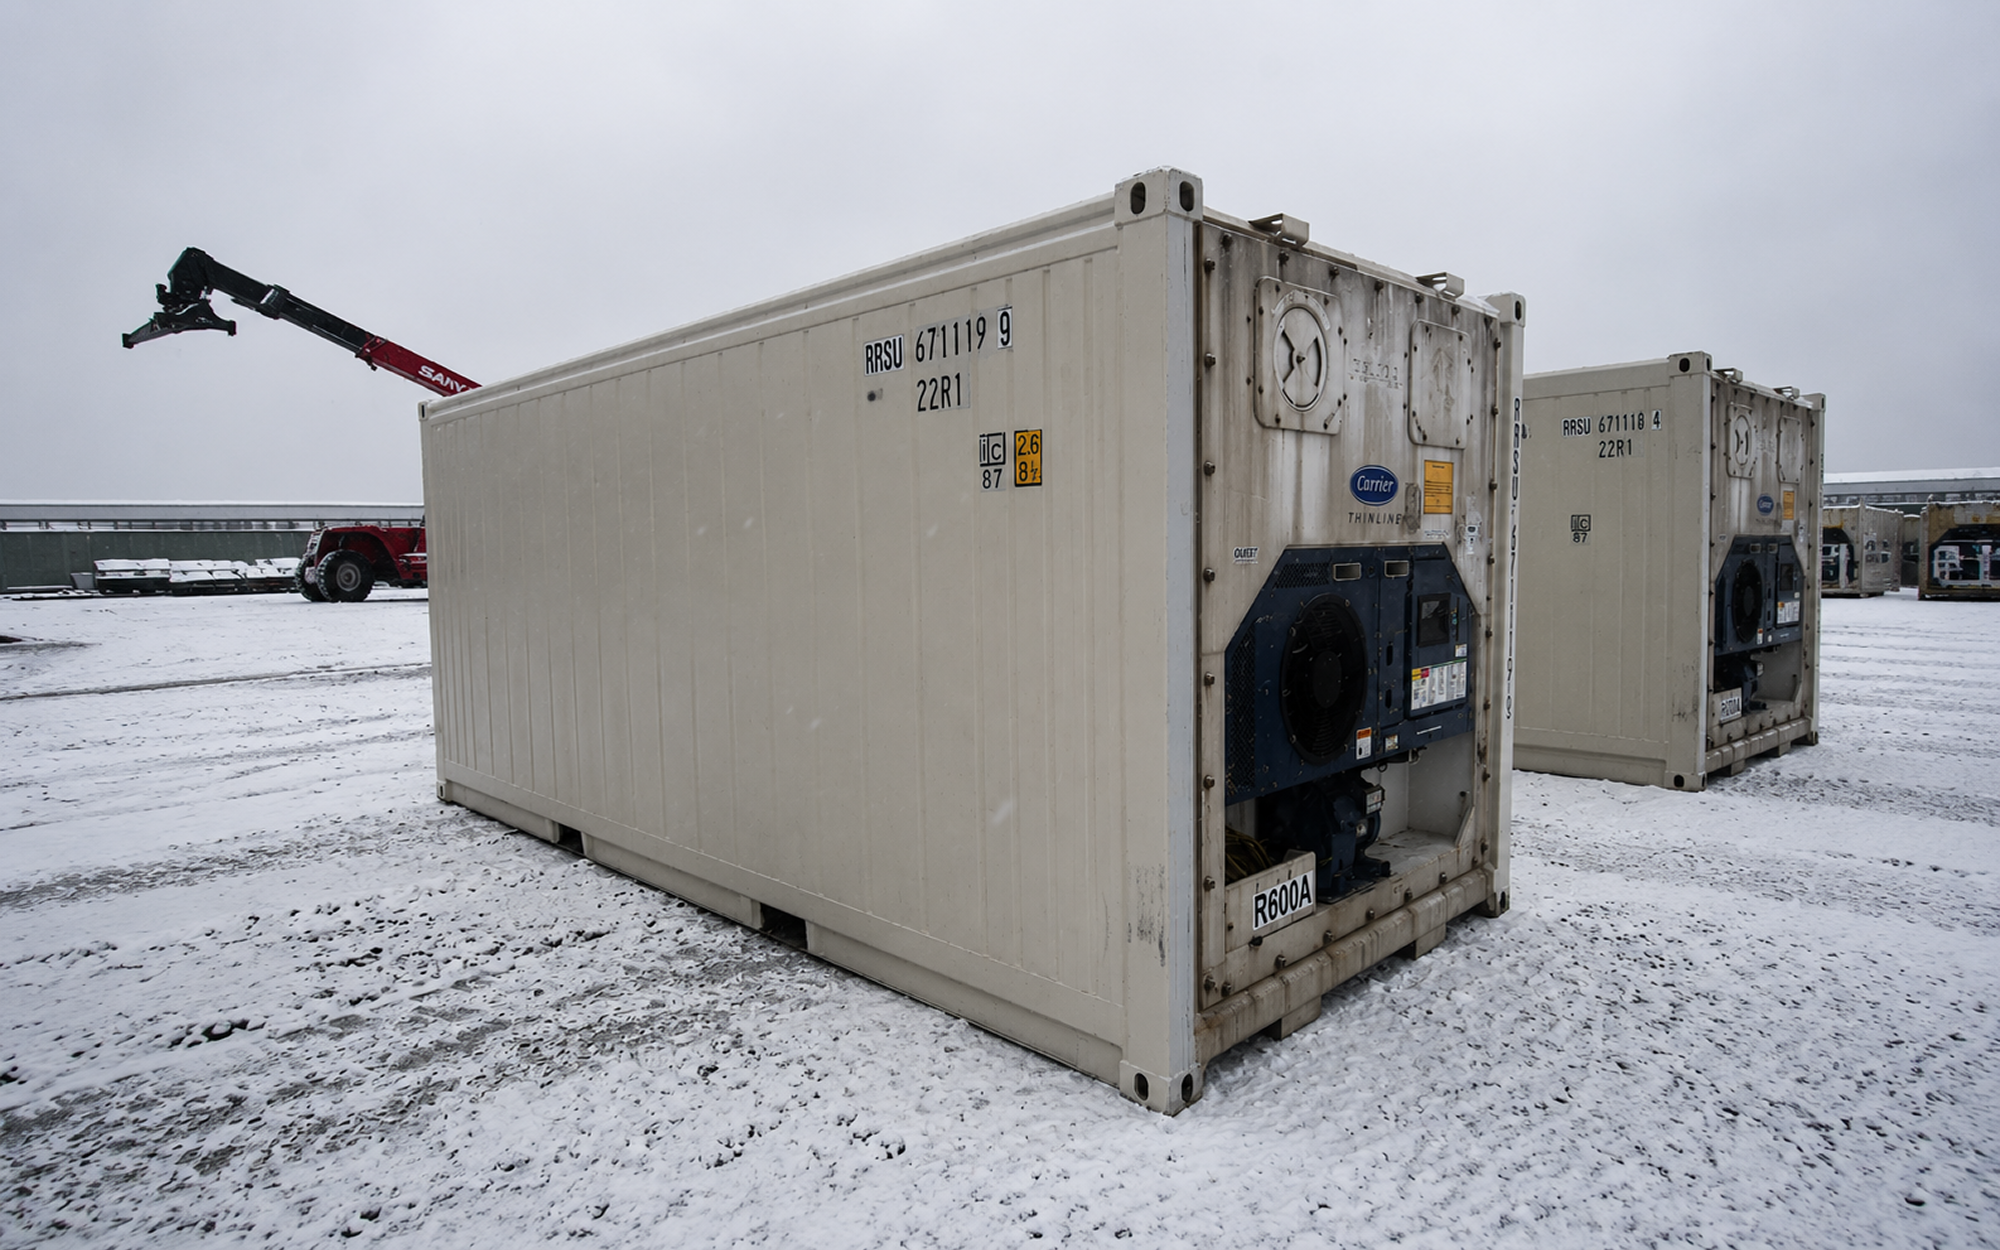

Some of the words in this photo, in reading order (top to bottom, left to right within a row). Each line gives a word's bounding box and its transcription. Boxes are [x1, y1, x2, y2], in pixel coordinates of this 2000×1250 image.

[865, 336, 904, 374] RRSU
[915, 316, 987, 362] 671119
[999, 310, 1011, 347] 9
[917, 372, 962, 413] 22R1
[1563, 417, 1591, 437] RRSU
[1598, 412, 1645, 434] 671118
[1653, 410, 1661, 429] 4
[1018, 433, 1040, 456] 2.6
[1598, 438, 1632, 459] 22R1
[982, 468, 1003, 490] 87
[1356, 474, 1395, 494] Carrier
[1348, 511, 1403, 525] THINLINE
[1572, 531, 1588, 544] 87
[1254, 874, 1313, 929] R600A
